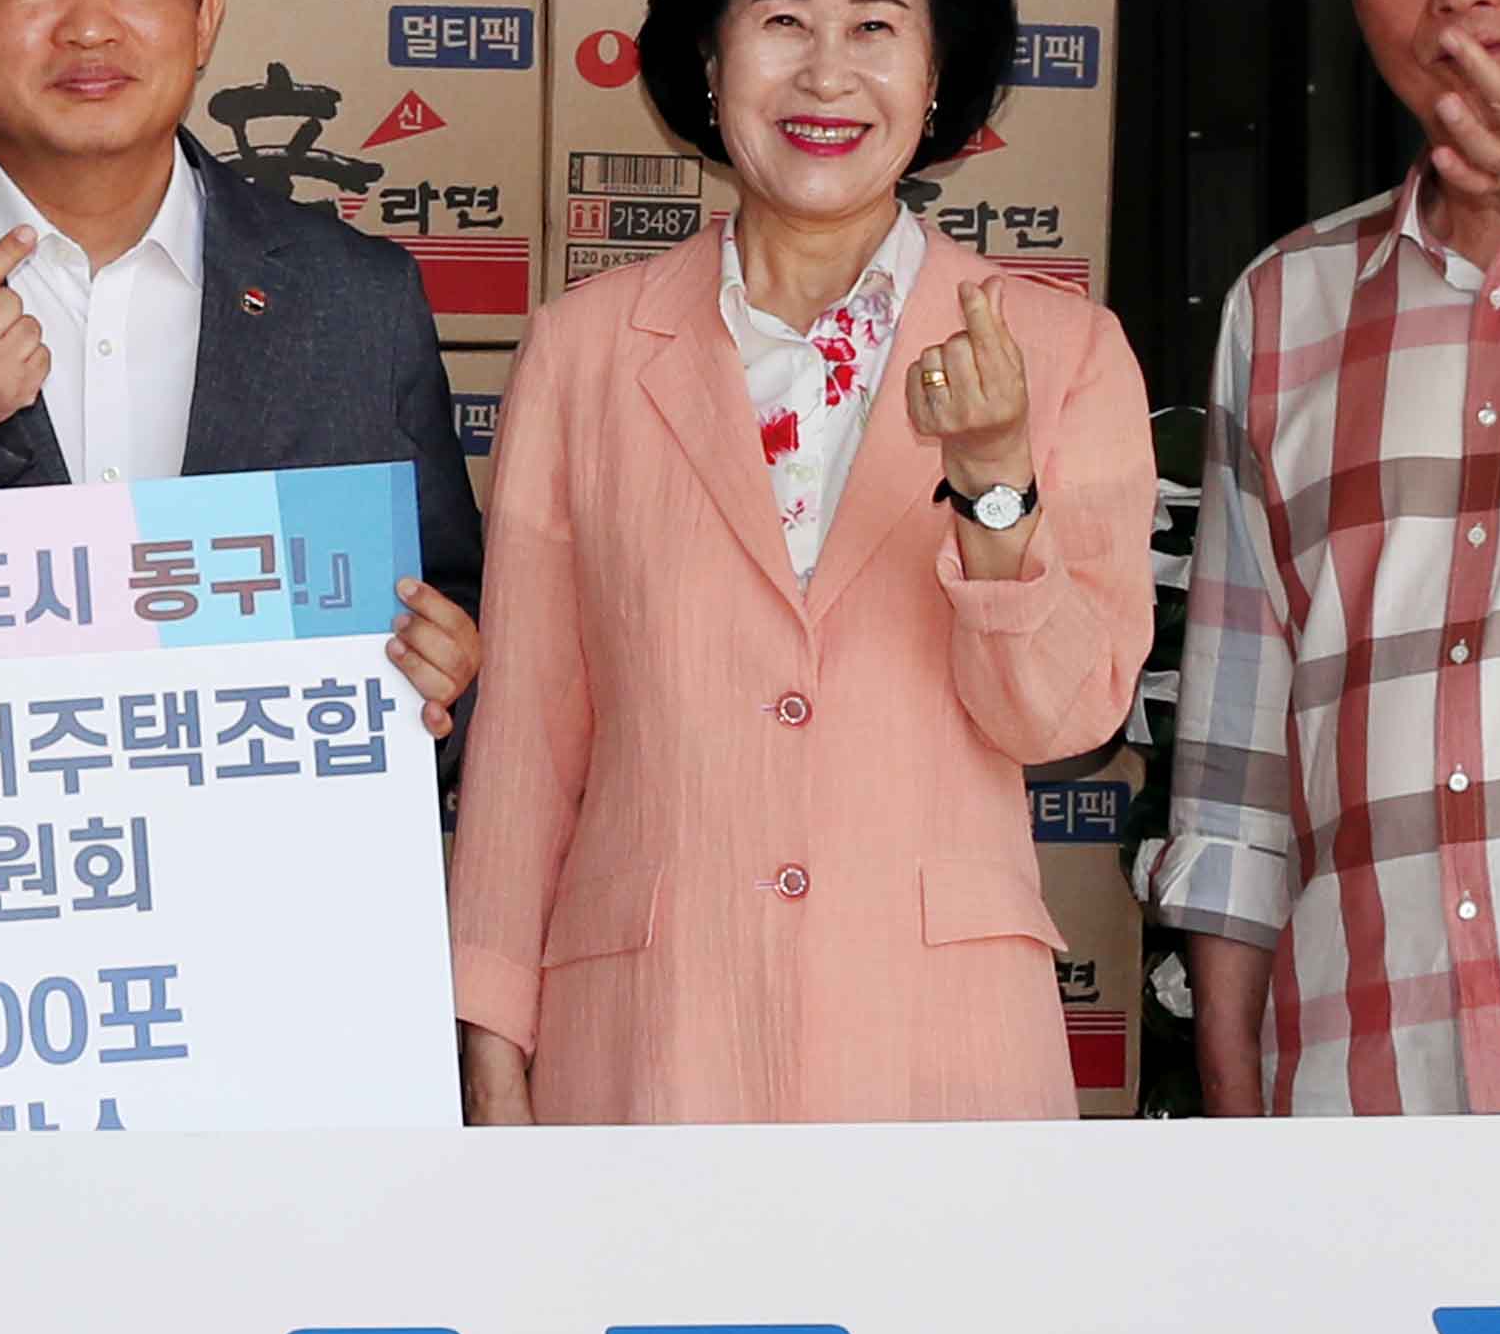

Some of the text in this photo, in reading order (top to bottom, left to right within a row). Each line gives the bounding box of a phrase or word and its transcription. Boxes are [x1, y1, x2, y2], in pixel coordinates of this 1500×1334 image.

[402, 14, 521, 61] 멀티팩
[1012, 33, 1086, 80] 티팩
[397, 105, 424, 131] 신
[379, 180, 504, 236] 라면
[613, 206, 697, 236] 가3487
[936, 200, 1065, 255] 라면
[126, 531, 355, 624] 동구!』
[1029, 789, 1116, 835] 티팩
